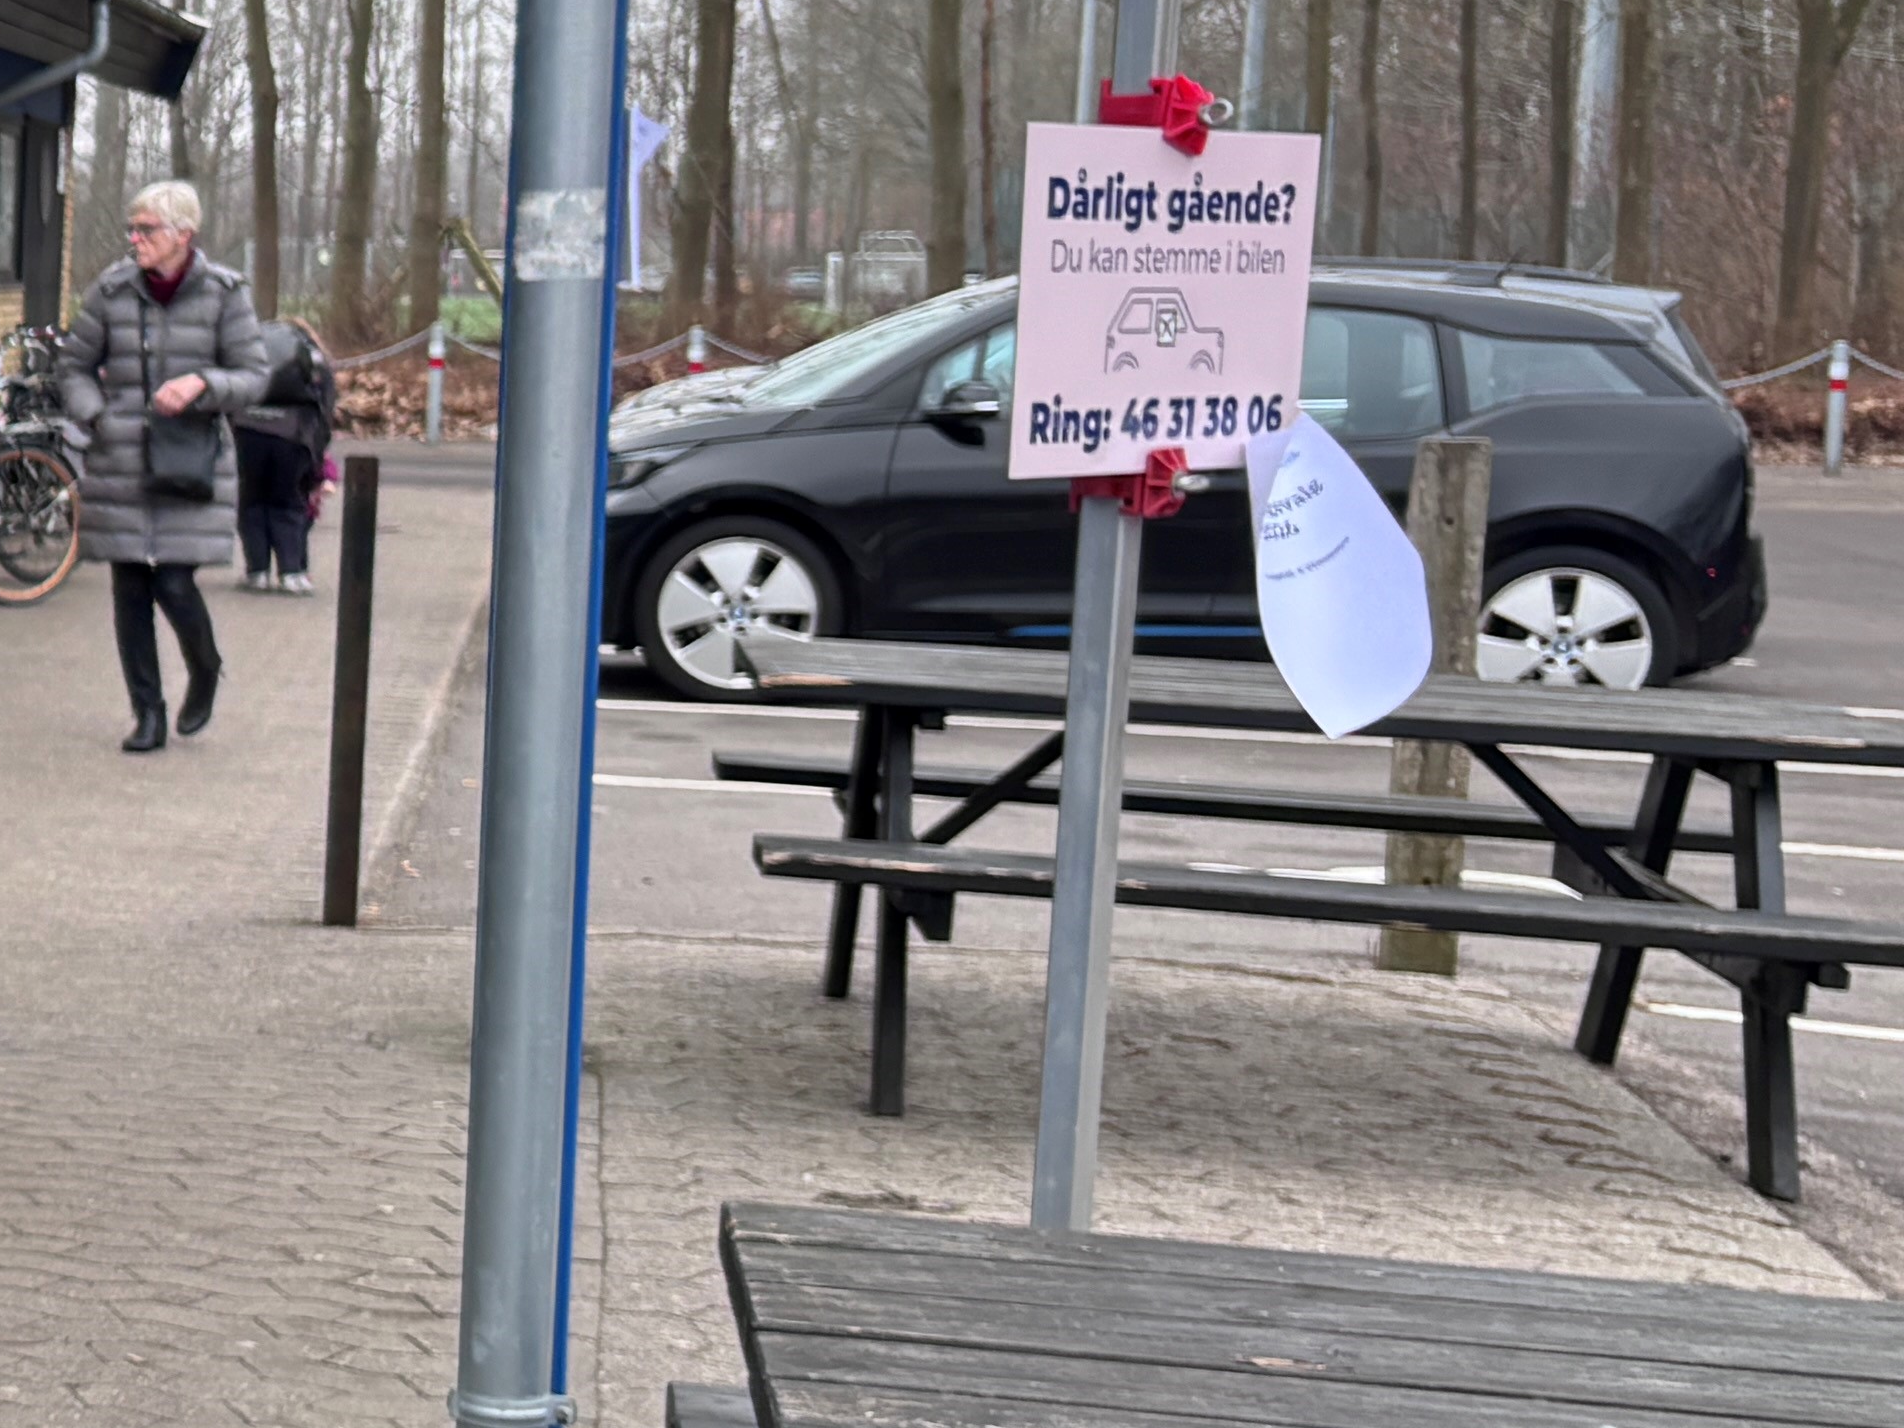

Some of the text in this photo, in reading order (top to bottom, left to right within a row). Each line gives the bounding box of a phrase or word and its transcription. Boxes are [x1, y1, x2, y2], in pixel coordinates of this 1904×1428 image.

[1047, 167, 1297, 233] Dårligt gående?
[1051, 237, 1285, 274] Du kan stemme i bilen
[1029, 393, 1283, 453] Ring: 46 31 38 06
